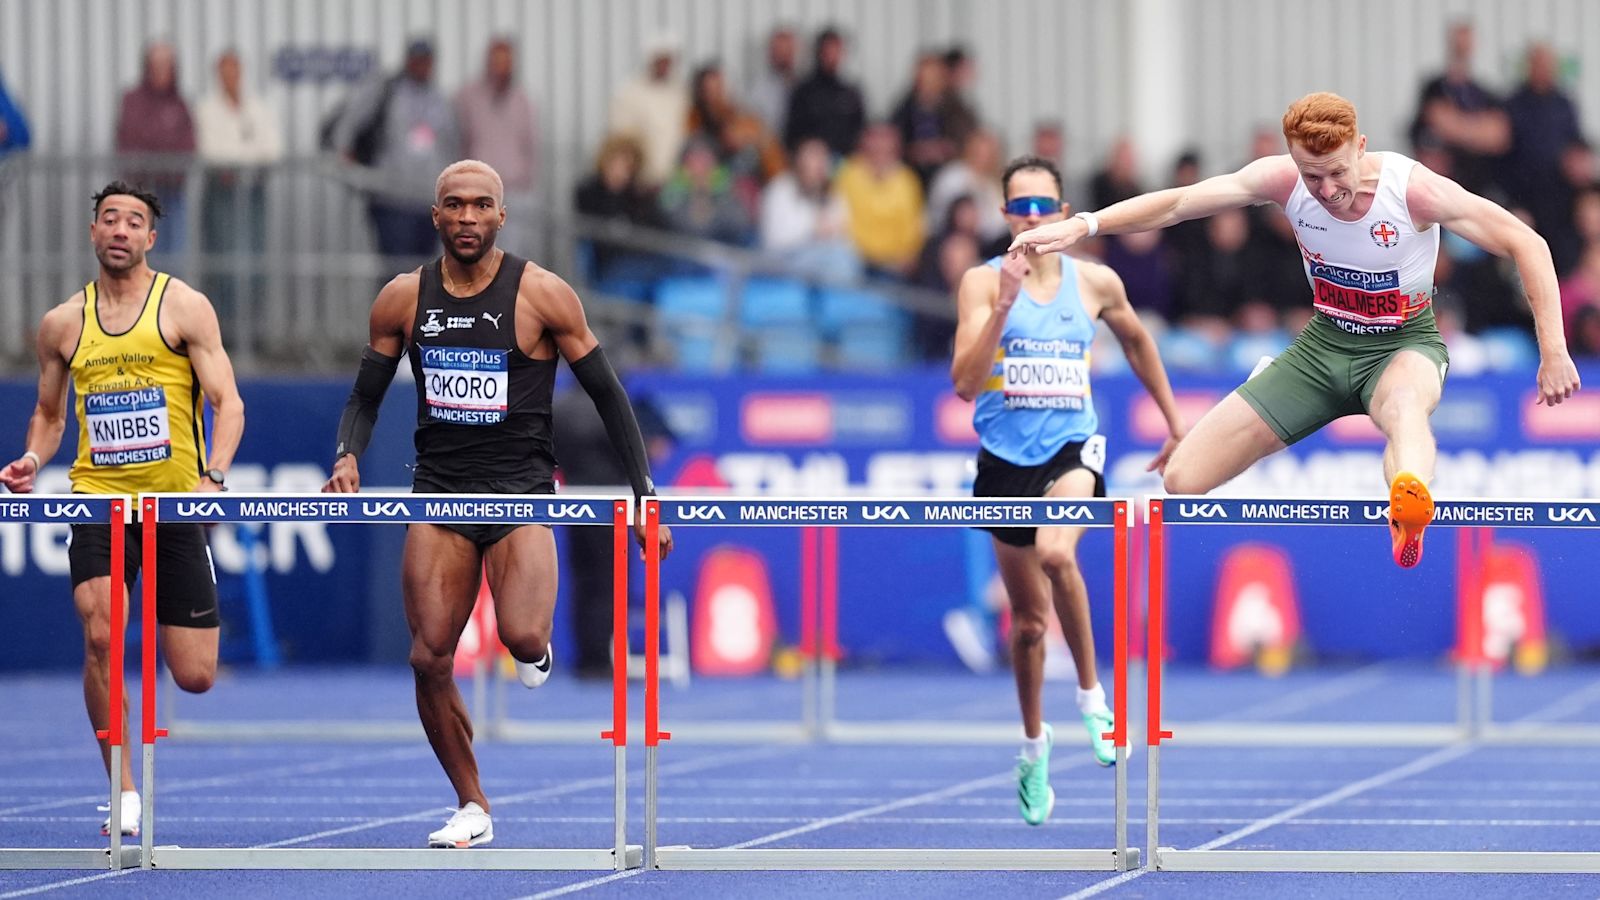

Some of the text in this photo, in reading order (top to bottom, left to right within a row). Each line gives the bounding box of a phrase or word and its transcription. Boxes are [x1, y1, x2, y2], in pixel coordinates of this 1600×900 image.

[1319, 283, 1398, 316] CHALMERS
[84, 353, 154, 369] Amber Valley
[116, 367, 125, 376] &
[1007, 364, 1083, 385] DONOVAN
[88, 379, 130, 393] Erewash
[431, 374, 497, 399] OKORO
[1008, 396, 1082, 410] MANCHESTER
[430, 407, 501, 424] MANCHESTER
[93, 415, 160, 442] KNIBBS
[94, 447, 167, 465] MANCHESTER
[43, 503, 93, 518] UKA
[177, 501, 597, 519] UKA MANCHESTER UKA MANCHESTER UKA
[677, 505, 1095, 520] UKA MANCHESTER UKA MANCHESTER UKA
[1179, 503, 1228, 518] UKA
[1241, 504, 1350, 519] MANCHESTER
[1363, 505, 1389, 520] UK
[1548, 507, 1597, 522] UKA
